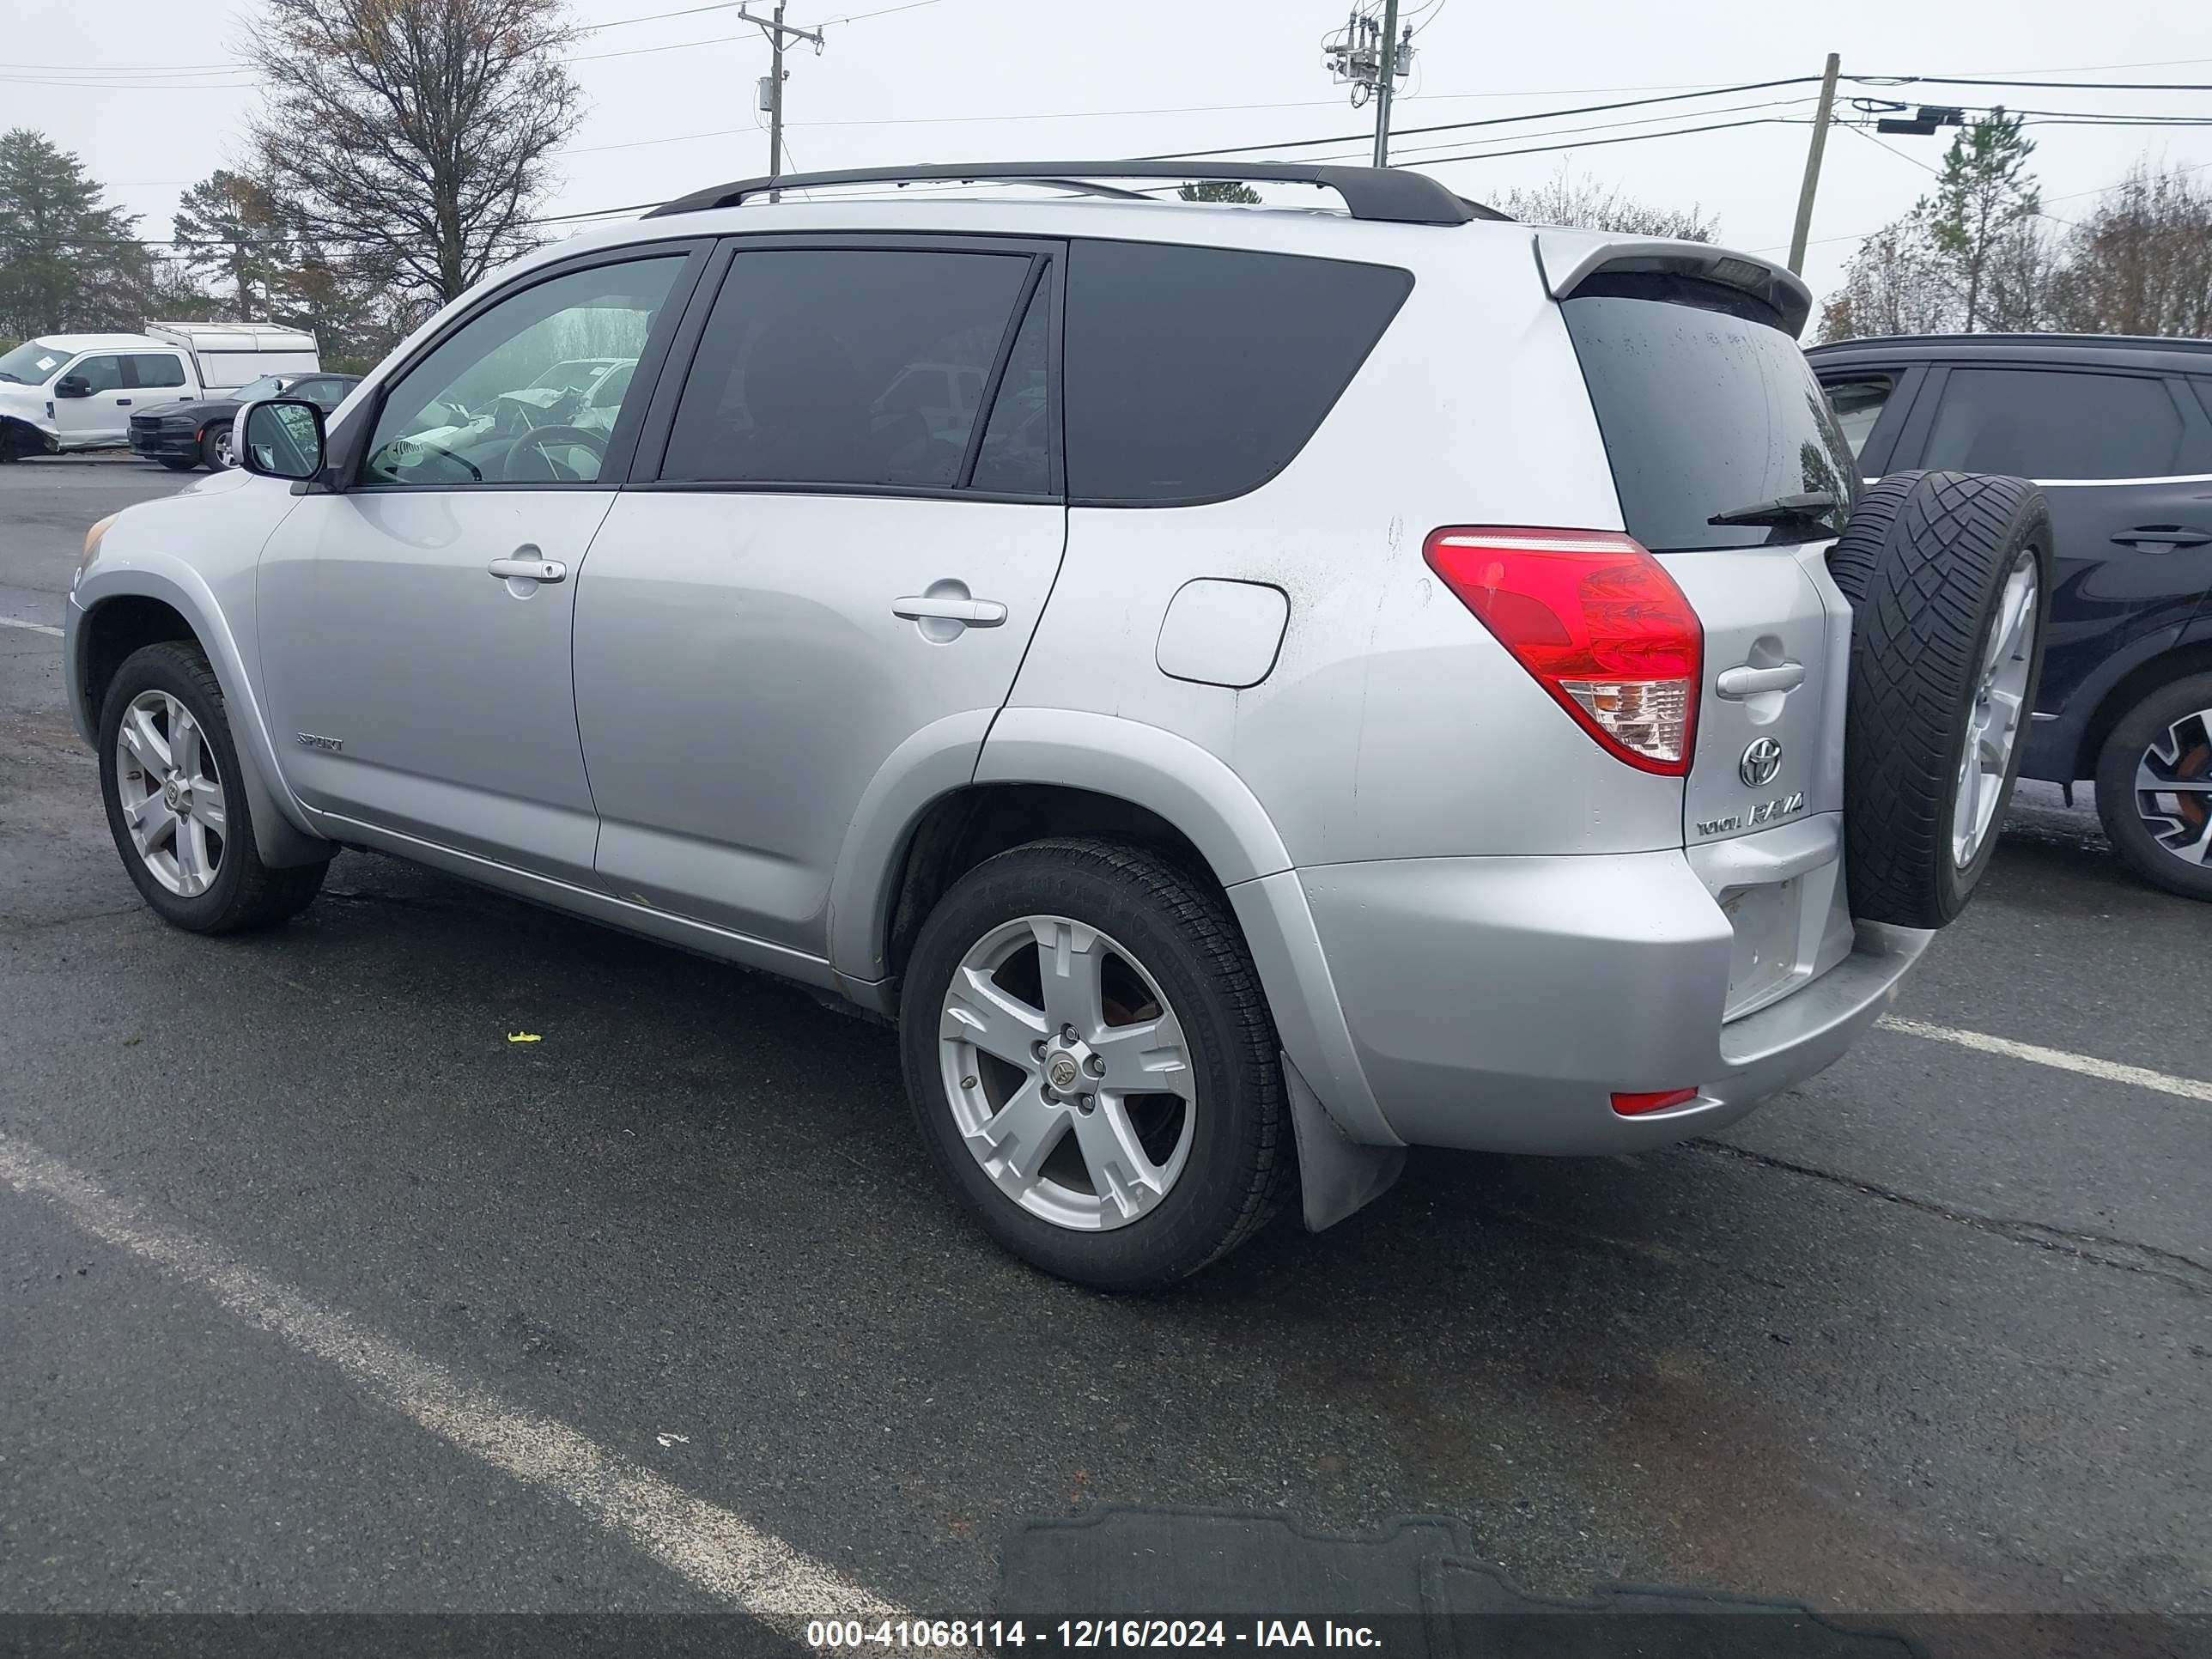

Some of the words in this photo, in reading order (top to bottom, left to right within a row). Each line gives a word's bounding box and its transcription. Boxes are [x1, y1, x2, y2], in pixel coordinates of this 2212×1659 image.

[296, 732, 343, 750] SPORT
[1697, 816, 1741, 836] TOYOTA
[1747, 792, 1804, 826] RAV4
